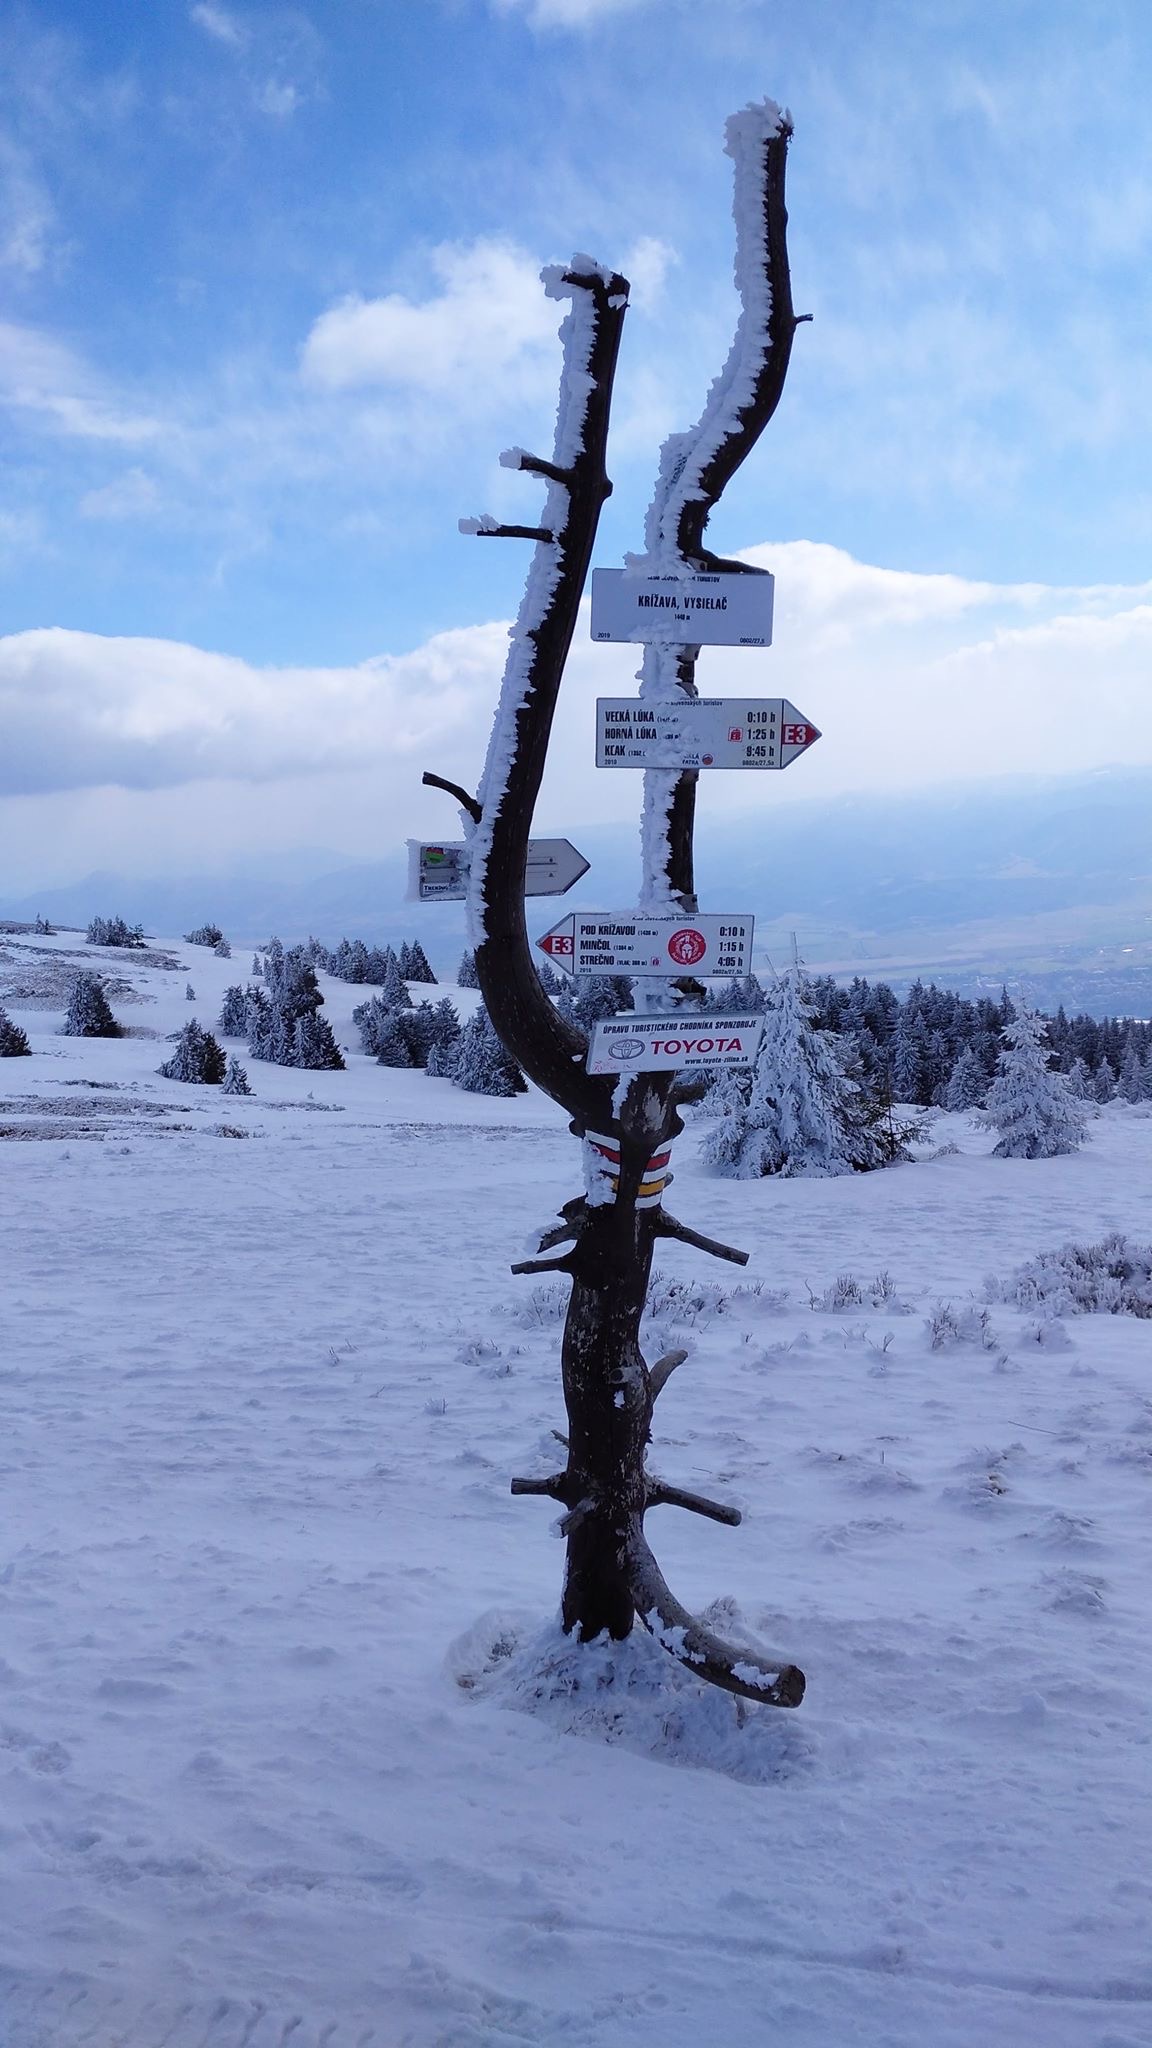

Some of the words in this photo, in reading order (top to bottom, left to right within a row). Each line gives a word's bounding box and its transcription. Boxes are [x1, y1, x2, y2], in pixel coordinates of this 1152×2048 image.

[638, 593, 680, 610] KRÍŽAVA,
[684, 596, 728, 610] VYSIELAČ
[605, 709, 630, 722] VEĽKÁ
[633, 709, 655, 723] LÚKA
[747, 711, 767, 723] 0:10
[770, 711, 776, 723] h
[605, 726, 633, 739] HORNÁ
[636, 726, 657, 740] LÚKA
[747, 728, 767, 740] 1:25
[770, 728, 775, 740] h
[784, 725, 807, 744] E3
[604, 745, 625, 757] KĽAK
[769, 746, 774, 757] h
[580, 925, 596, 936] POD
[598, 923, 636, 936] KRÍŽAVOU
[719, 926, 738, 937] 0:10
[739, 926, 745, 937] h
[551, 937, 572, 953] E3
[580, 938, 612, 951] MINČOL
[719, 942, 737, 952] 1:15
[739, 942, 744, 952] h
[580, 953, 615, 966] STREČNO
[717, 956, 736, 967] 4:05
[738, 956, 743, 967] h
[603, 1023, 629, 1035] ÚPRAVU
[631, 1021, 678, 1034] TURISTICKÉHO
[680, 1020, 713, 1031] CHODNÍKA
[715, 1019, 758, 1030] SPONZORUJE
[650, 1038, 742, 1055] TOYOTA
[684, 1056, 749, 1067] www.toyota-zilina.sk
